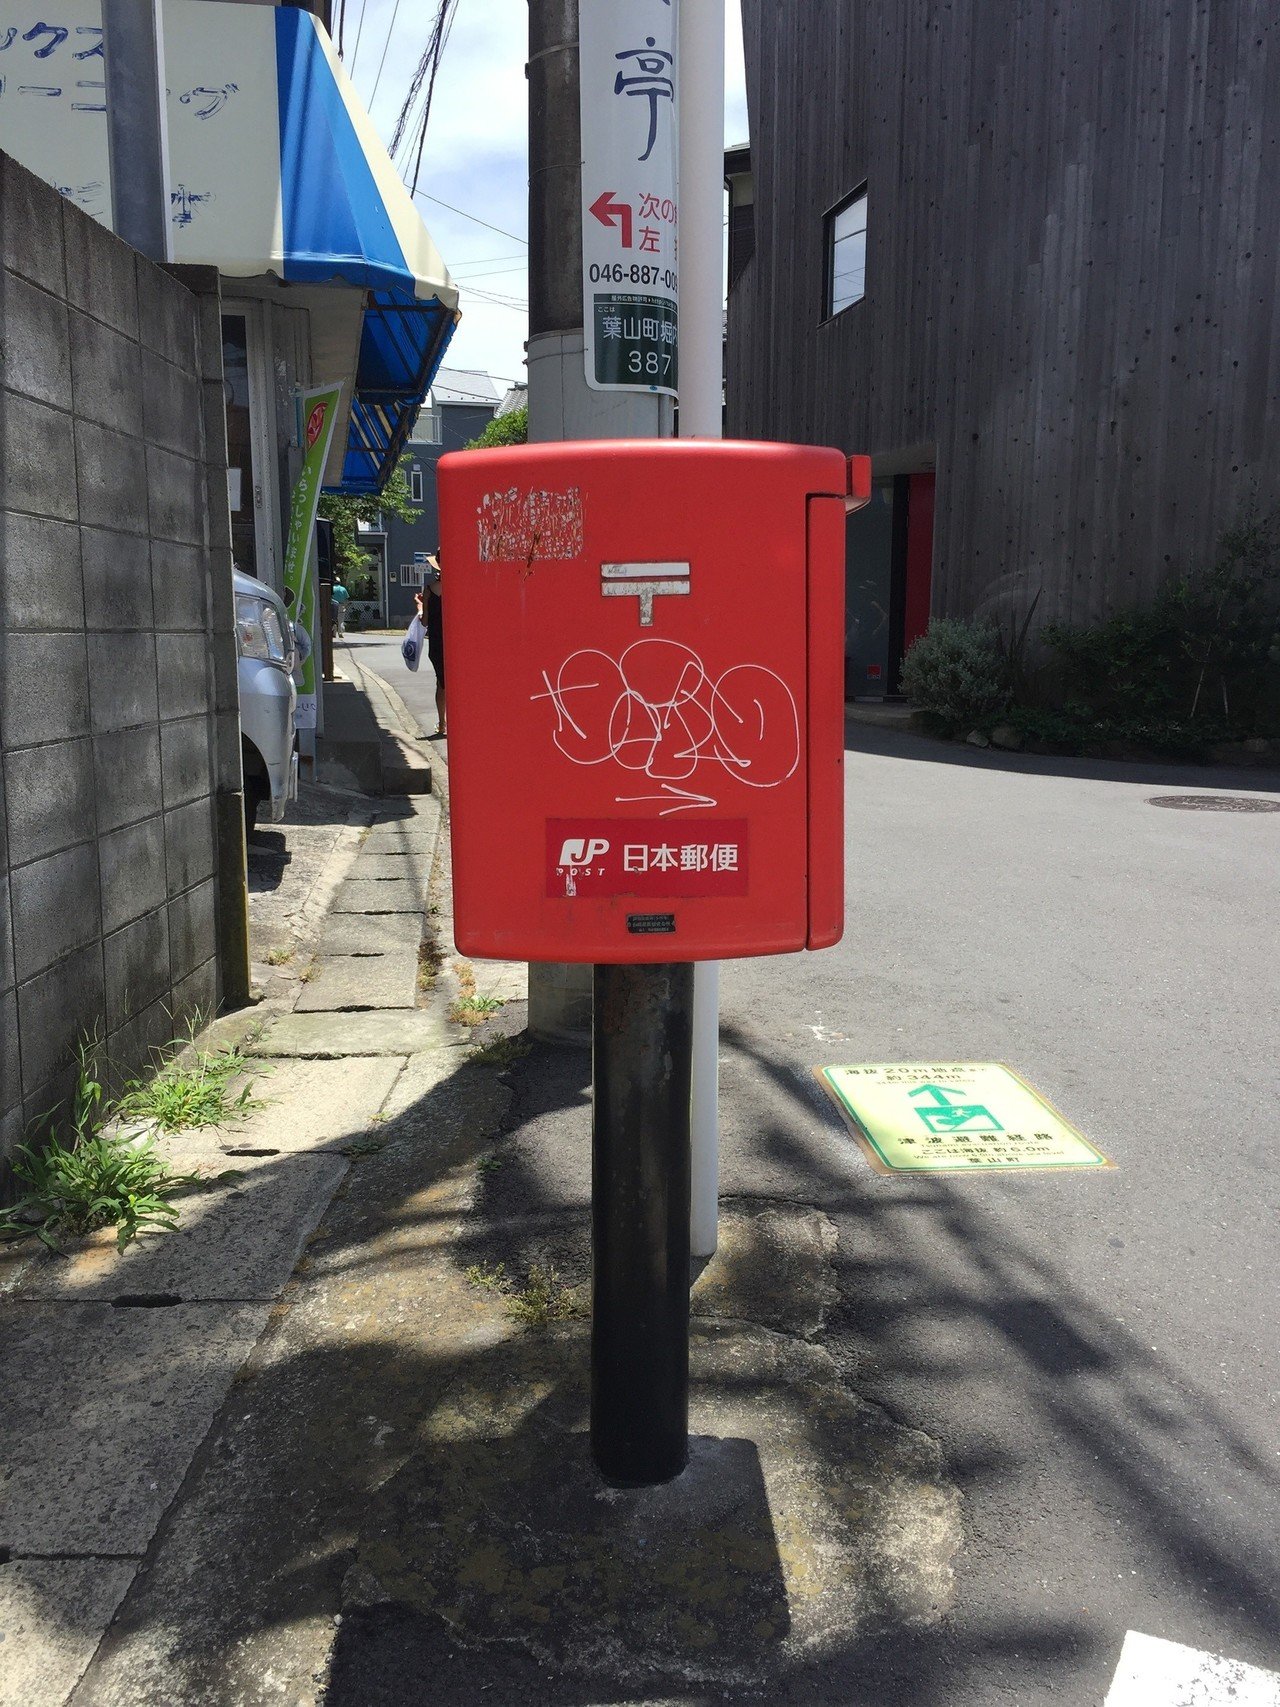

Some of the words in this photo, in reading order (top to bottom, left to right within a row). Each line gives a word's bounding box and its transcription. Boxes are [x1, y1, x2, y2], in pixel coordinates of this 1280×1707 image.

[614, 0, 674, 161] 亭
[638, 192, 678, 225] 次の
[628, 350, 671, 375] 387
[555, 867, 606, 876] POST
[623, 843, 739, 872] 日本郵便
